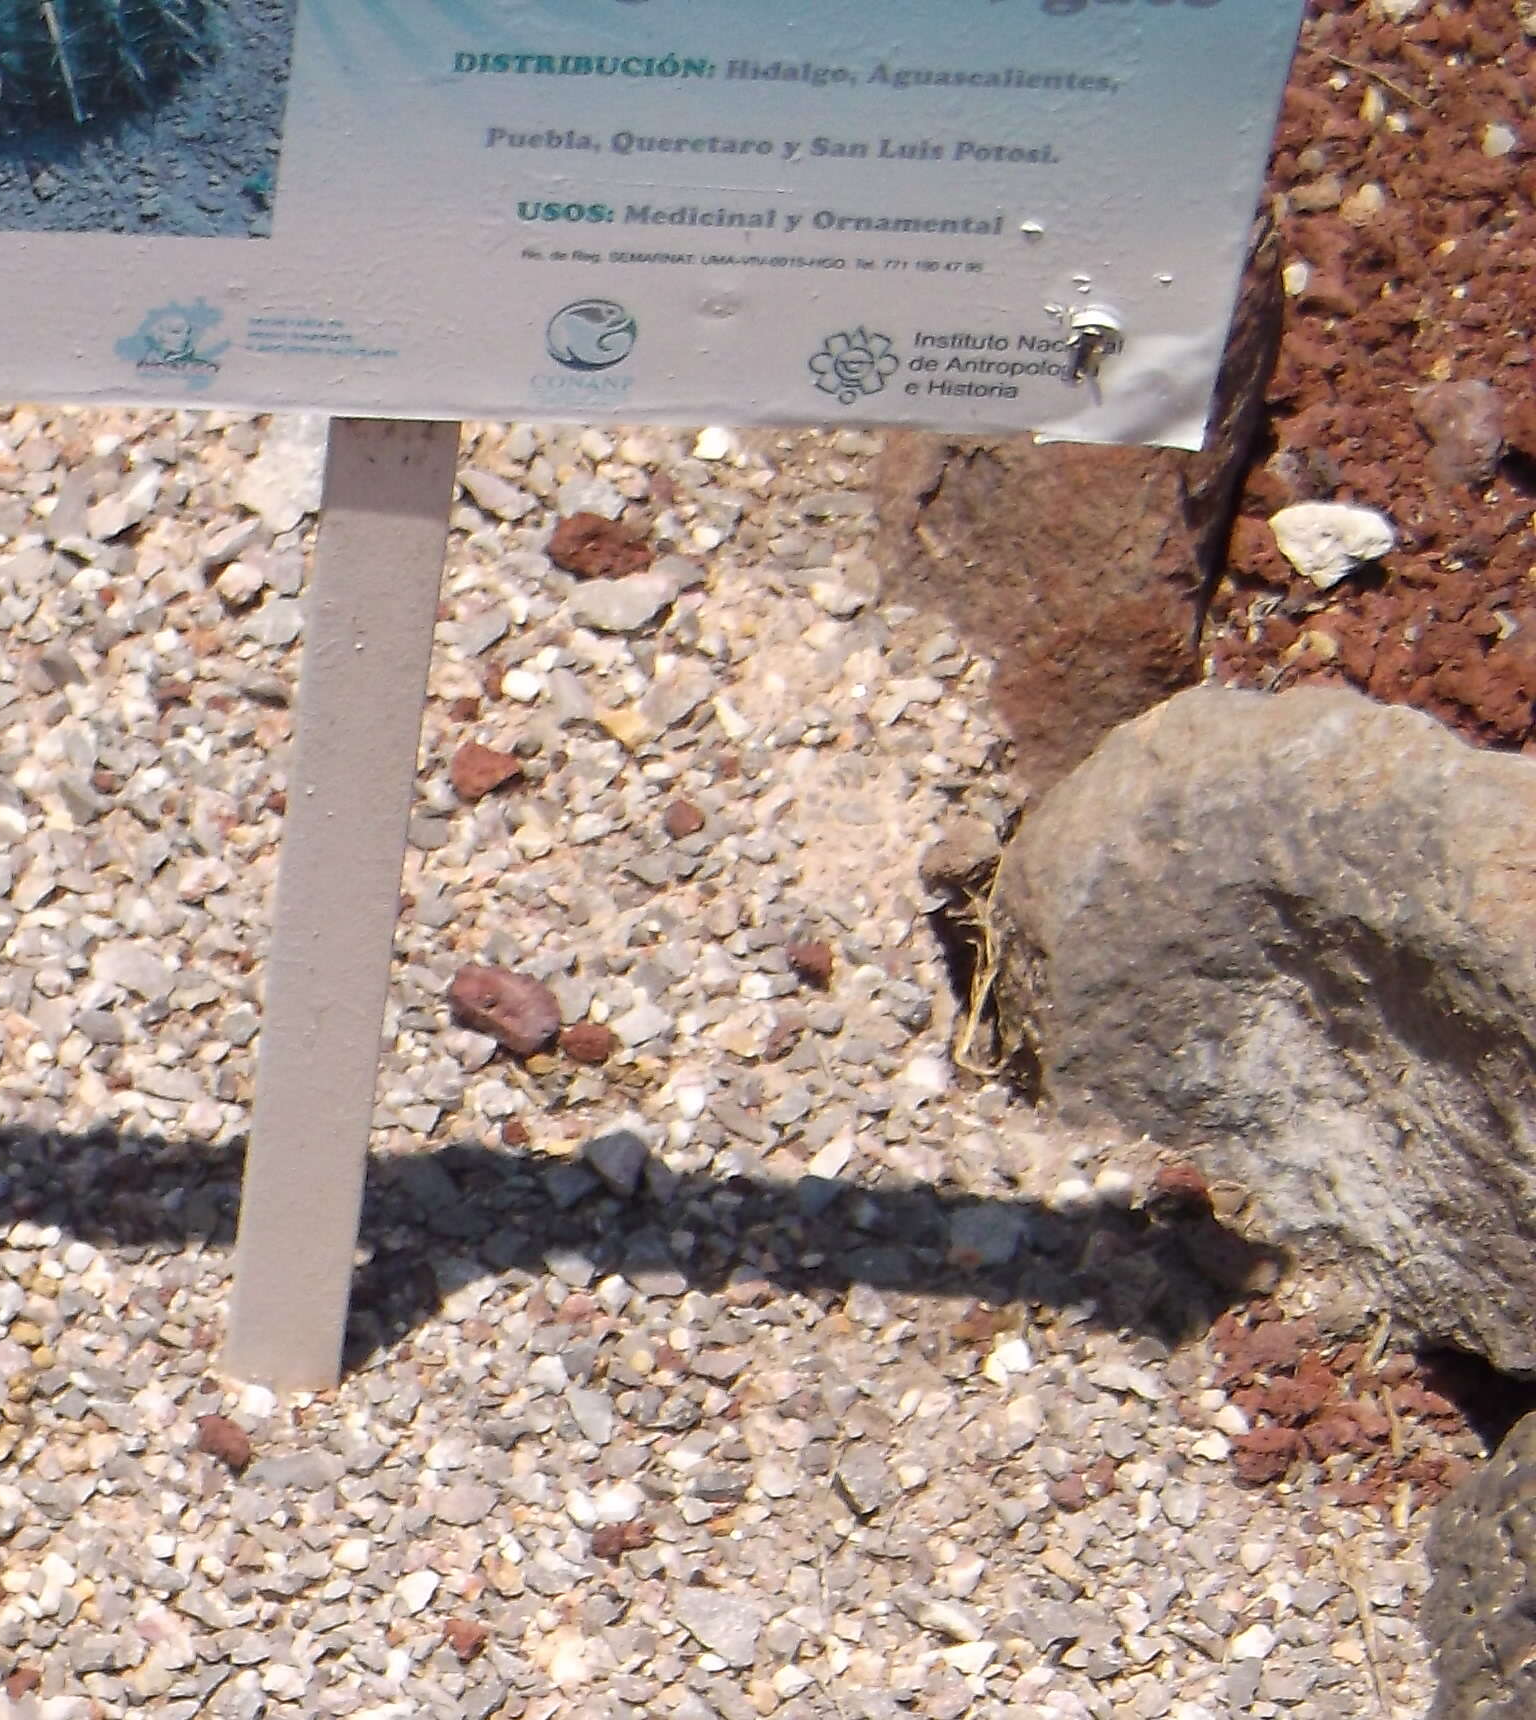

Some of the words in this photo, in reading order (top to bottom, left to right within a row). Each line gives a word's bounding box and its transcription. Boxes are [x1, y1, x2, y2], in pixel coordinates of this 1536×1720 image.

[453, 51, 717, 81] DISTRIBUCIÓN:
[725, 58, 858, 87] Hidalgo,
[867, 62, 1121, 94] Aguascalientes,
[484, 126, 602, 153] Puebla,
[611, 131, 774, 159] Queretaro
[781, 140, 801, 163] y
[810, 135, 868, 158] San
[879, 137, 943, 161] Luis
[516, 200, 615, 223] USOS:
[624, 204, 775, 229] Medicinal
[786, 213, 801, 232] y
[813, 210, 1004, 235] Ornamental
[913, 331, 1009, 352] Instituto
[907, 356, 937, 372] de
[904, 383, 919, 396] e
[928, 381, 1019, 399] Historia
